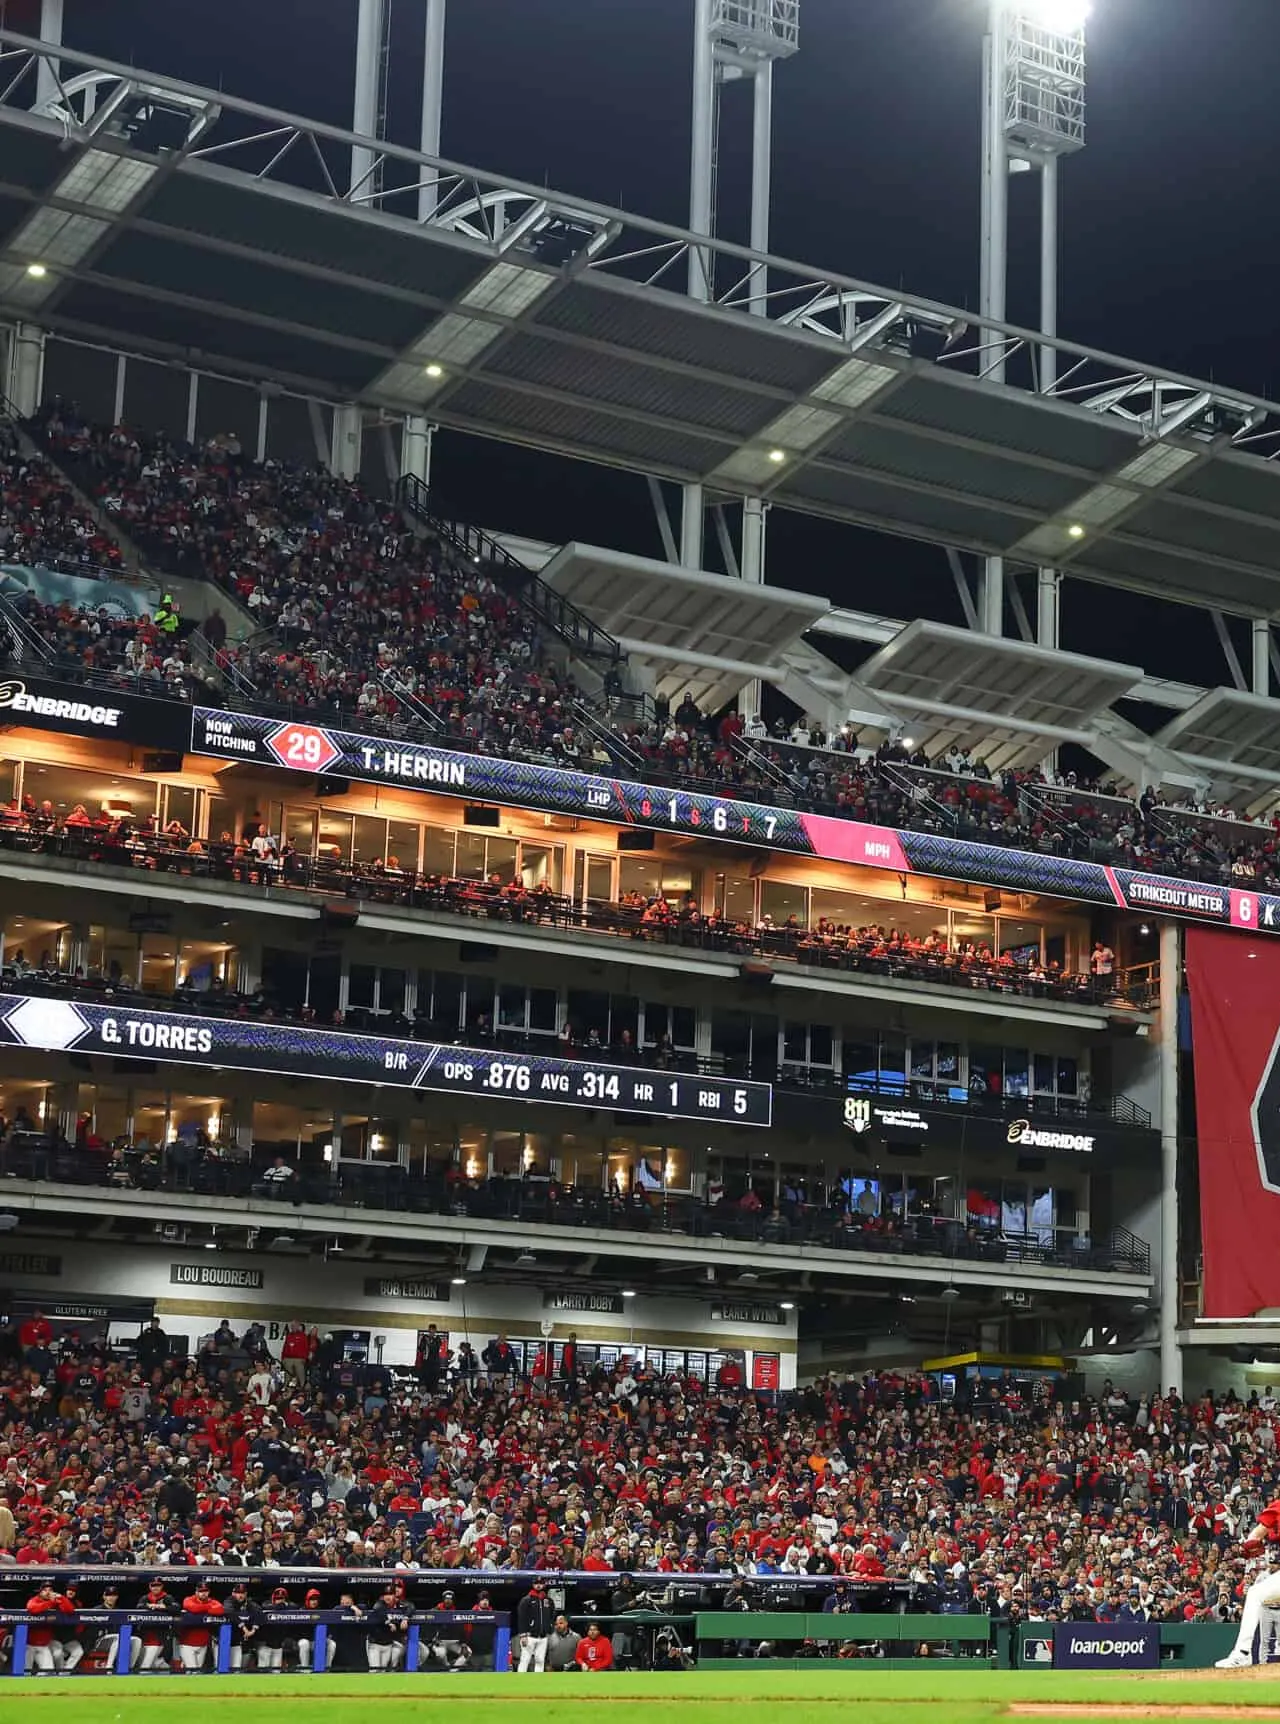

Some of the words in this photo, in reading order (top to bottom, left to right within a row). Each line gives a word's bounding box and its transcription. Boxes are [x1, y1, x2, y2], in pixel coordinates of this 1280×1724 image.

[11, 694, 120, 727] ENBRIDGE
[206, 719, 233, 734] NOW
[205, 732, 256, 752] PITCHING
[287, 732, 321, 764] 29
[384, 752, 465, 785] HERRIN
[588, 790, 610, 805] LHP
[668, 797, 677, 823] 1
[714, 807, 727, 831] 6
[742, 818, 752, 832] T
[765, 816, 777, 839] 7
[864, 841, 891, 858] MPH
[1129, 883, 1188, 907] STRIKEOUT
[1188, 894, 1224, 913] METER
[1240, 897, 1251, 921] 6
[101, 1018, 121, 1044] G.
[125, 1021, 212, 1053] TORRES
[385, 1051, 407, 1071] B/R
[444, 1061, 473, 1081] OPS
[483, 1062, 530, 1091] .876
[541, 1074, 569, 1092] AVG
[576, 1071, 619, 1100] .314
[634, 1084, 653, 1102] HR
[669, 1082, 678, 1106] 1
[699, 1090, 720, 1109] RBI
[734, 1090, 747, 1114] 5
[844, 1097, 870, 1121] 811
[1021, 1129, 1093, 1151] ENBRIDGE
[177, 1266, 199, 1282] LOU
[201, 1267, 260, 1287] BOUDREAU
[402, 1281, 437, 1299] LEMON
[55, 1306, 87, 1316] GLUTEN
[88, 1308, 108, 1317] FREE
[1070, 1637, 1145, 1657] loanDepot
